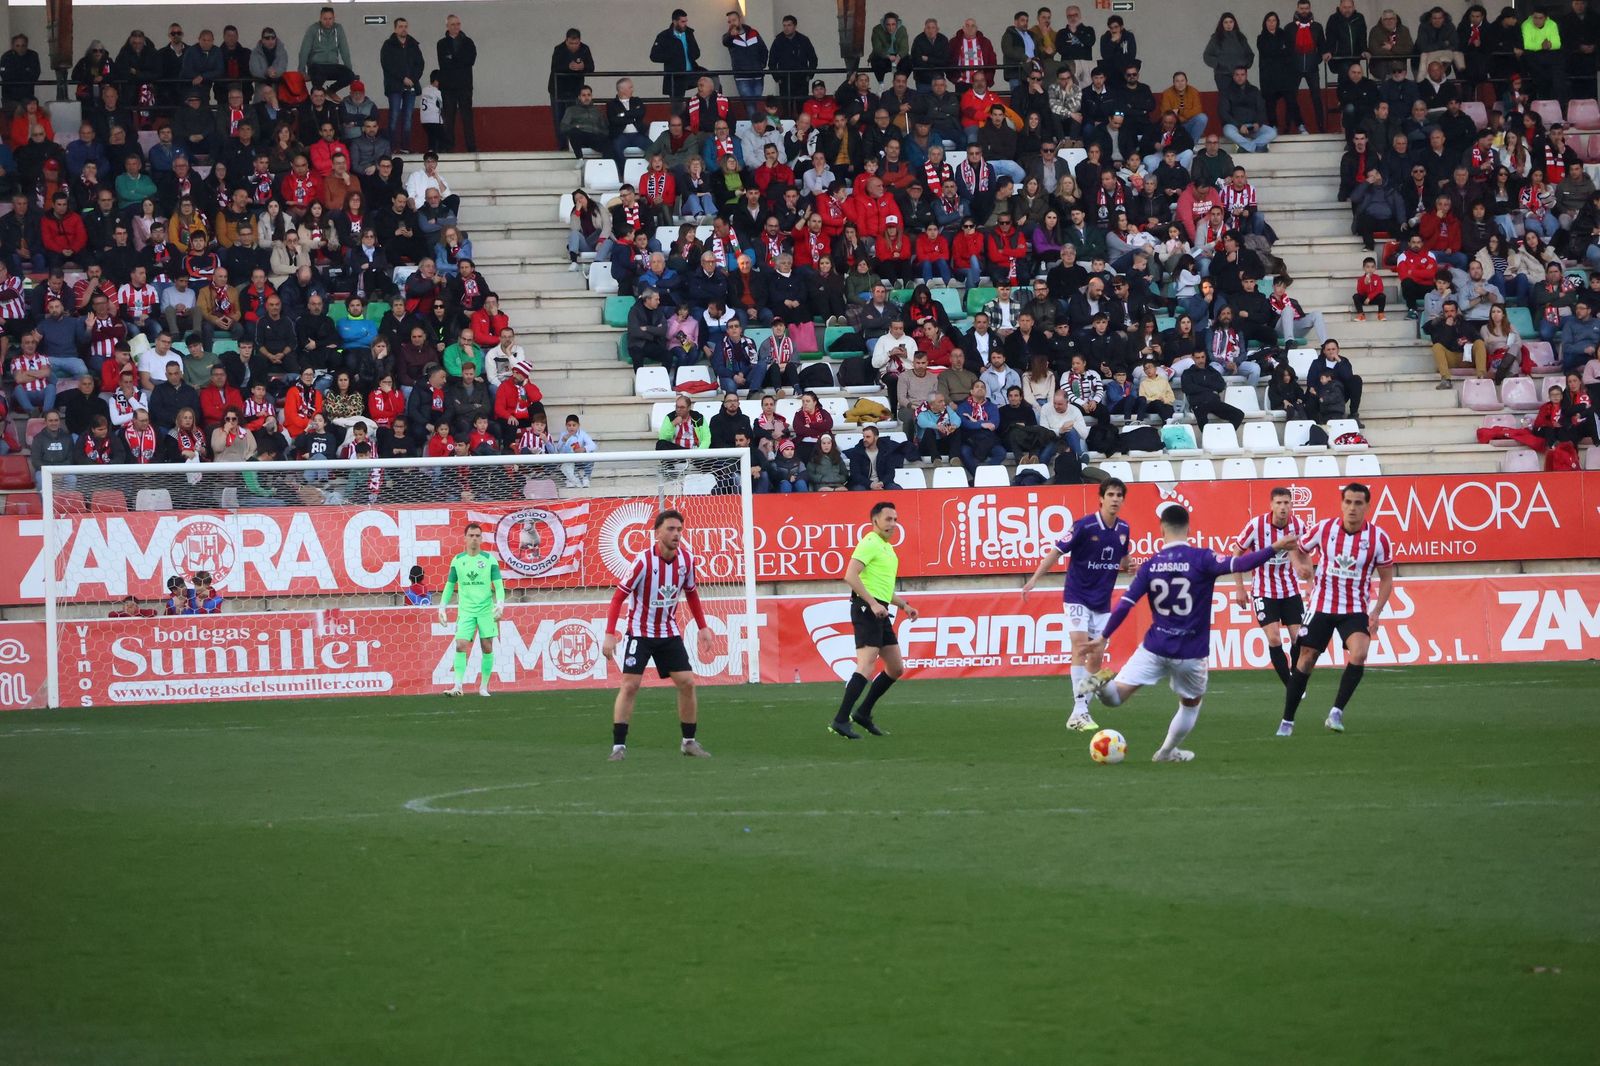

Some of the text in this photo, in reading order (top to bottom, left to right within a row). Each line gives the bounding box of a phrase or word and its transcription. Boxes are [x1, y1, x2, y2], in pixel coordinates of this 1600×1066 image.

[421, 98, 428, 111] 5
[968, 493, 1074, 545] fisio
[623, 526, 767, 555] CNTRO
[19, 508, 449, 598] ZAMORA CF
[507, 555, 558, 571] MODORRO
[1149, 562, 1190, 573] J.CASADO
[1150, 577, 1193, 616] 23
[1254, 598, 1265, 611] 16
[1069, 605, 1084, 617] 20
[154, 619, 356, 644] bodegas del
[111, 628, 381, 678] Sumiller
[629, 639, 638, 654] 8
[1428, 638, 1478, 662] S.L.
[114, 677, 383, 698] www.bodegasdelsumiller.com
